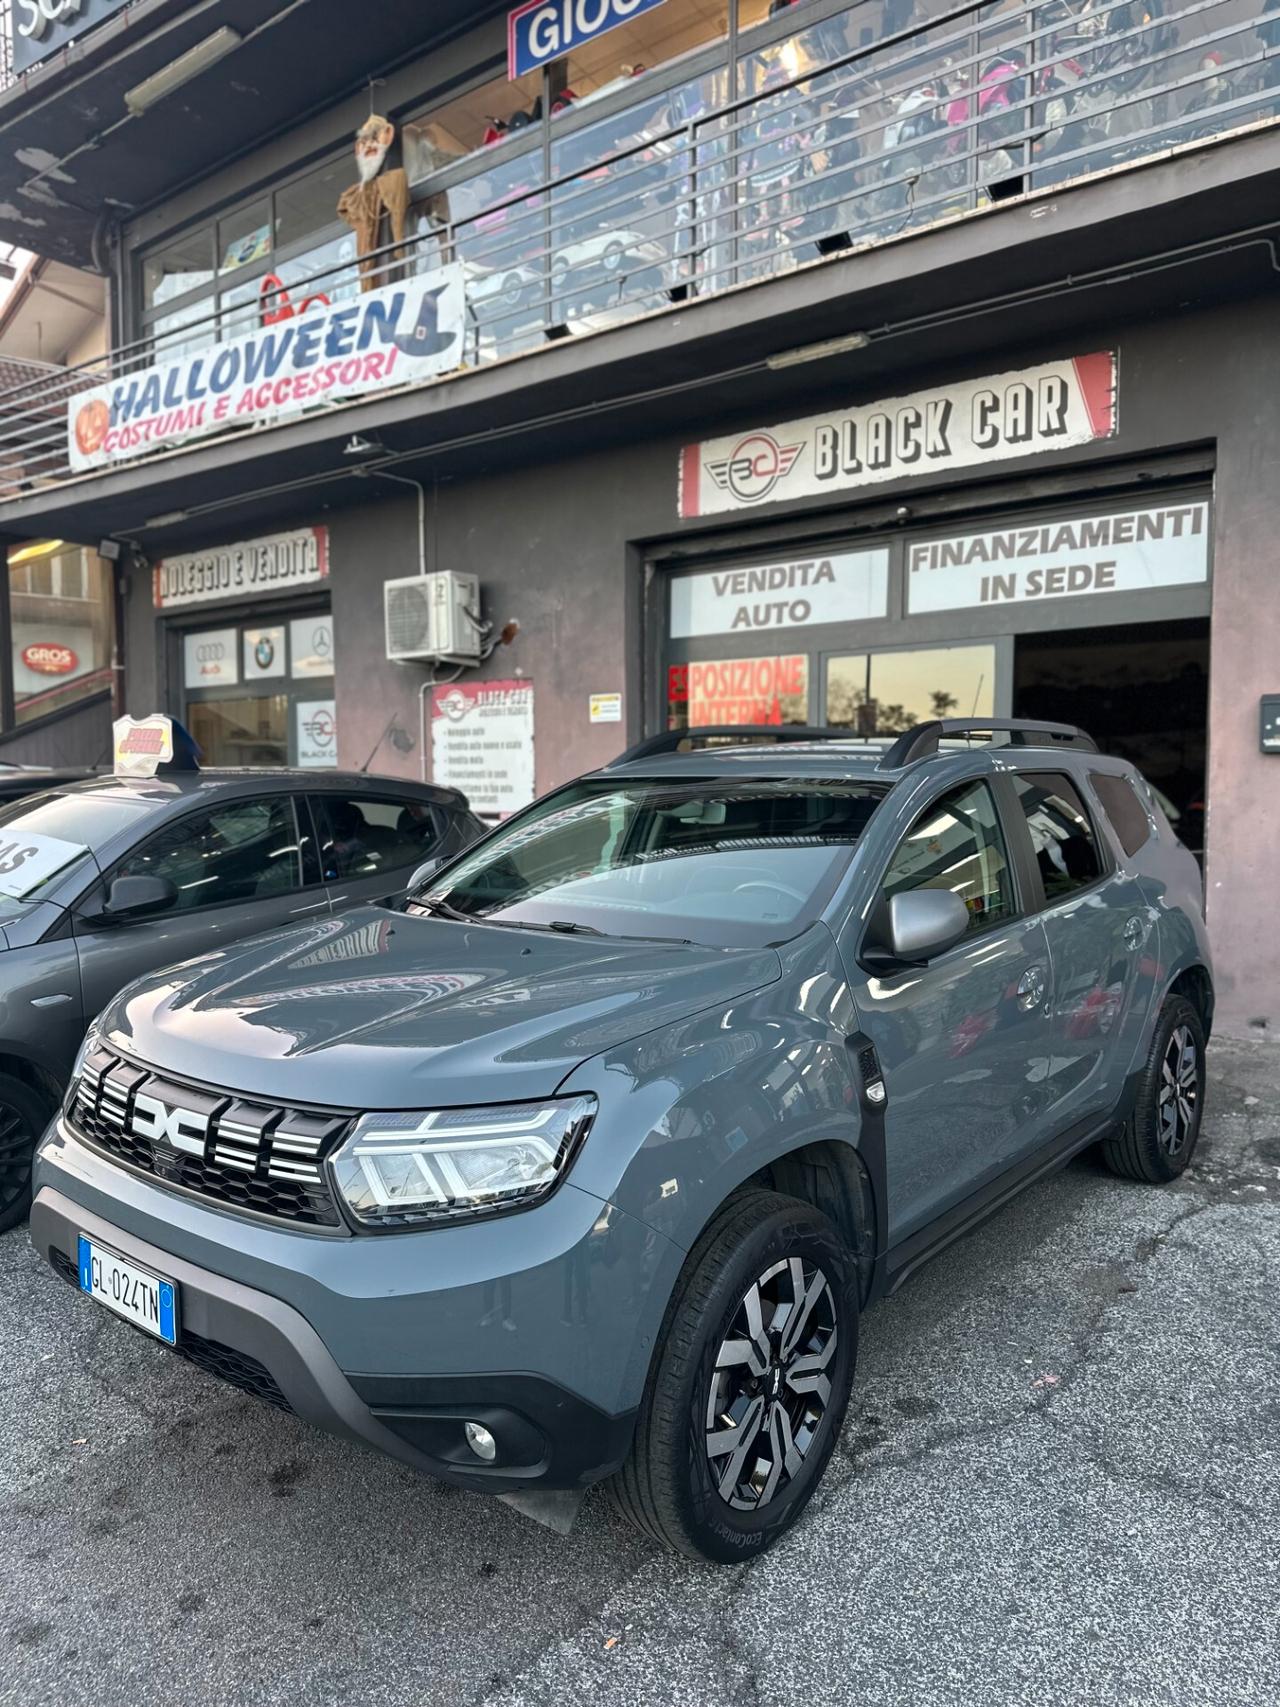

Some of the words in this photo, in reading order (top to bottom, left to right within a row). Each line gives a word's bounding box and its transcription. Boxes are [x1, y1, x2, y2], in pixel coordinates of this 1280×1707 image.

[109, 292, 406, 428] HALLOWEEN
[102, 401, 206, 453] COSTUMI
[213, 395, 231, 421] E
[236, 345, 399, 414] ACCESSORI
[814, 399, 953, 480] BLACK
[971, 374, 1068, 448] CAR
[160, 553, 230, 599] NOLEGGIO
[234, 551, 243, 585] E
[250, 535, 319, 583] VENDITA
[911, 506, 1204, 572] FINANZIAMENTI
[711, 560, 836, 597] VENDITA
[979, 573, 1017, 602] IN
[1025, 560, 1116, 597] SEDE
[730, 599, 812, 629] AUTO
[26, 647, 72, 663] GROS
[668, 655, 804, 703] ESPOSIZIONE
